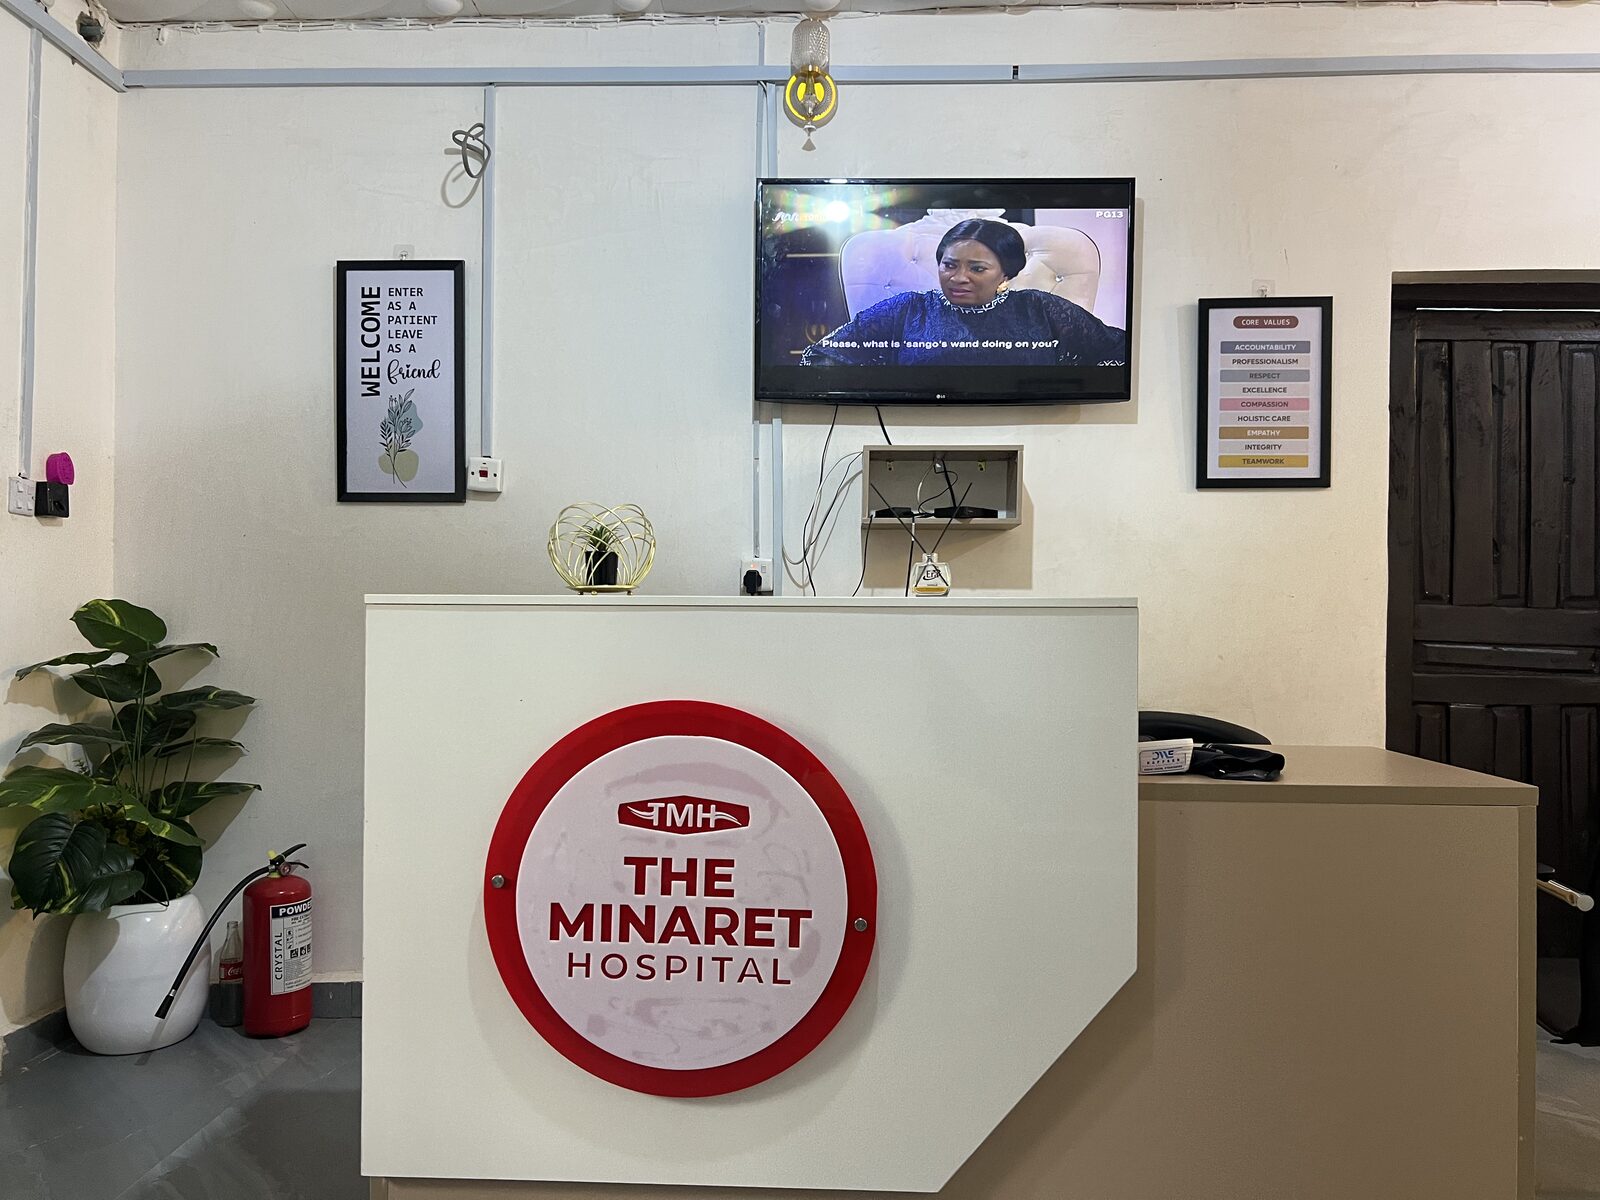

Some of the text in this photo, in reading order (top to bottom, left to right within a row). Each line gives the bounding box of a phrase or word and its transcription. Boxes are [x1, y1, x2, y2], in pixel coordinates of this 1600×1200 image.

[1095, 210, 1124, 218] PG13
[388, 287, 424, 297] ENTER
[387, 301, 417, 311] AS A
[387, 315, 438, 325] PATIENT
[1263, 318, 1291, 326] VALUES
[387, 329, 423, 339] LEAVE
[361, 286, 381, 397] WELCOME
[822, 340, 860, 349] Please,
[862, 340, 889, 348] what
[891, 340, 900, 348] is
[950, 340, 980, 348] wand
[981, 340, 1013, 350] doing
[1032, 340, 1059, 349] you?
[387, 343, 417, 353] AS A
[387, 359, 441, 384] friend
[647, 802, 717, 828] TMH
[623, 856, 735, 898] THE
[549, 902, 813, 949] MINARET
[274, 932, 283, 980] CRYSTAL
[567, 952, 792, 985] HOSPITAL
